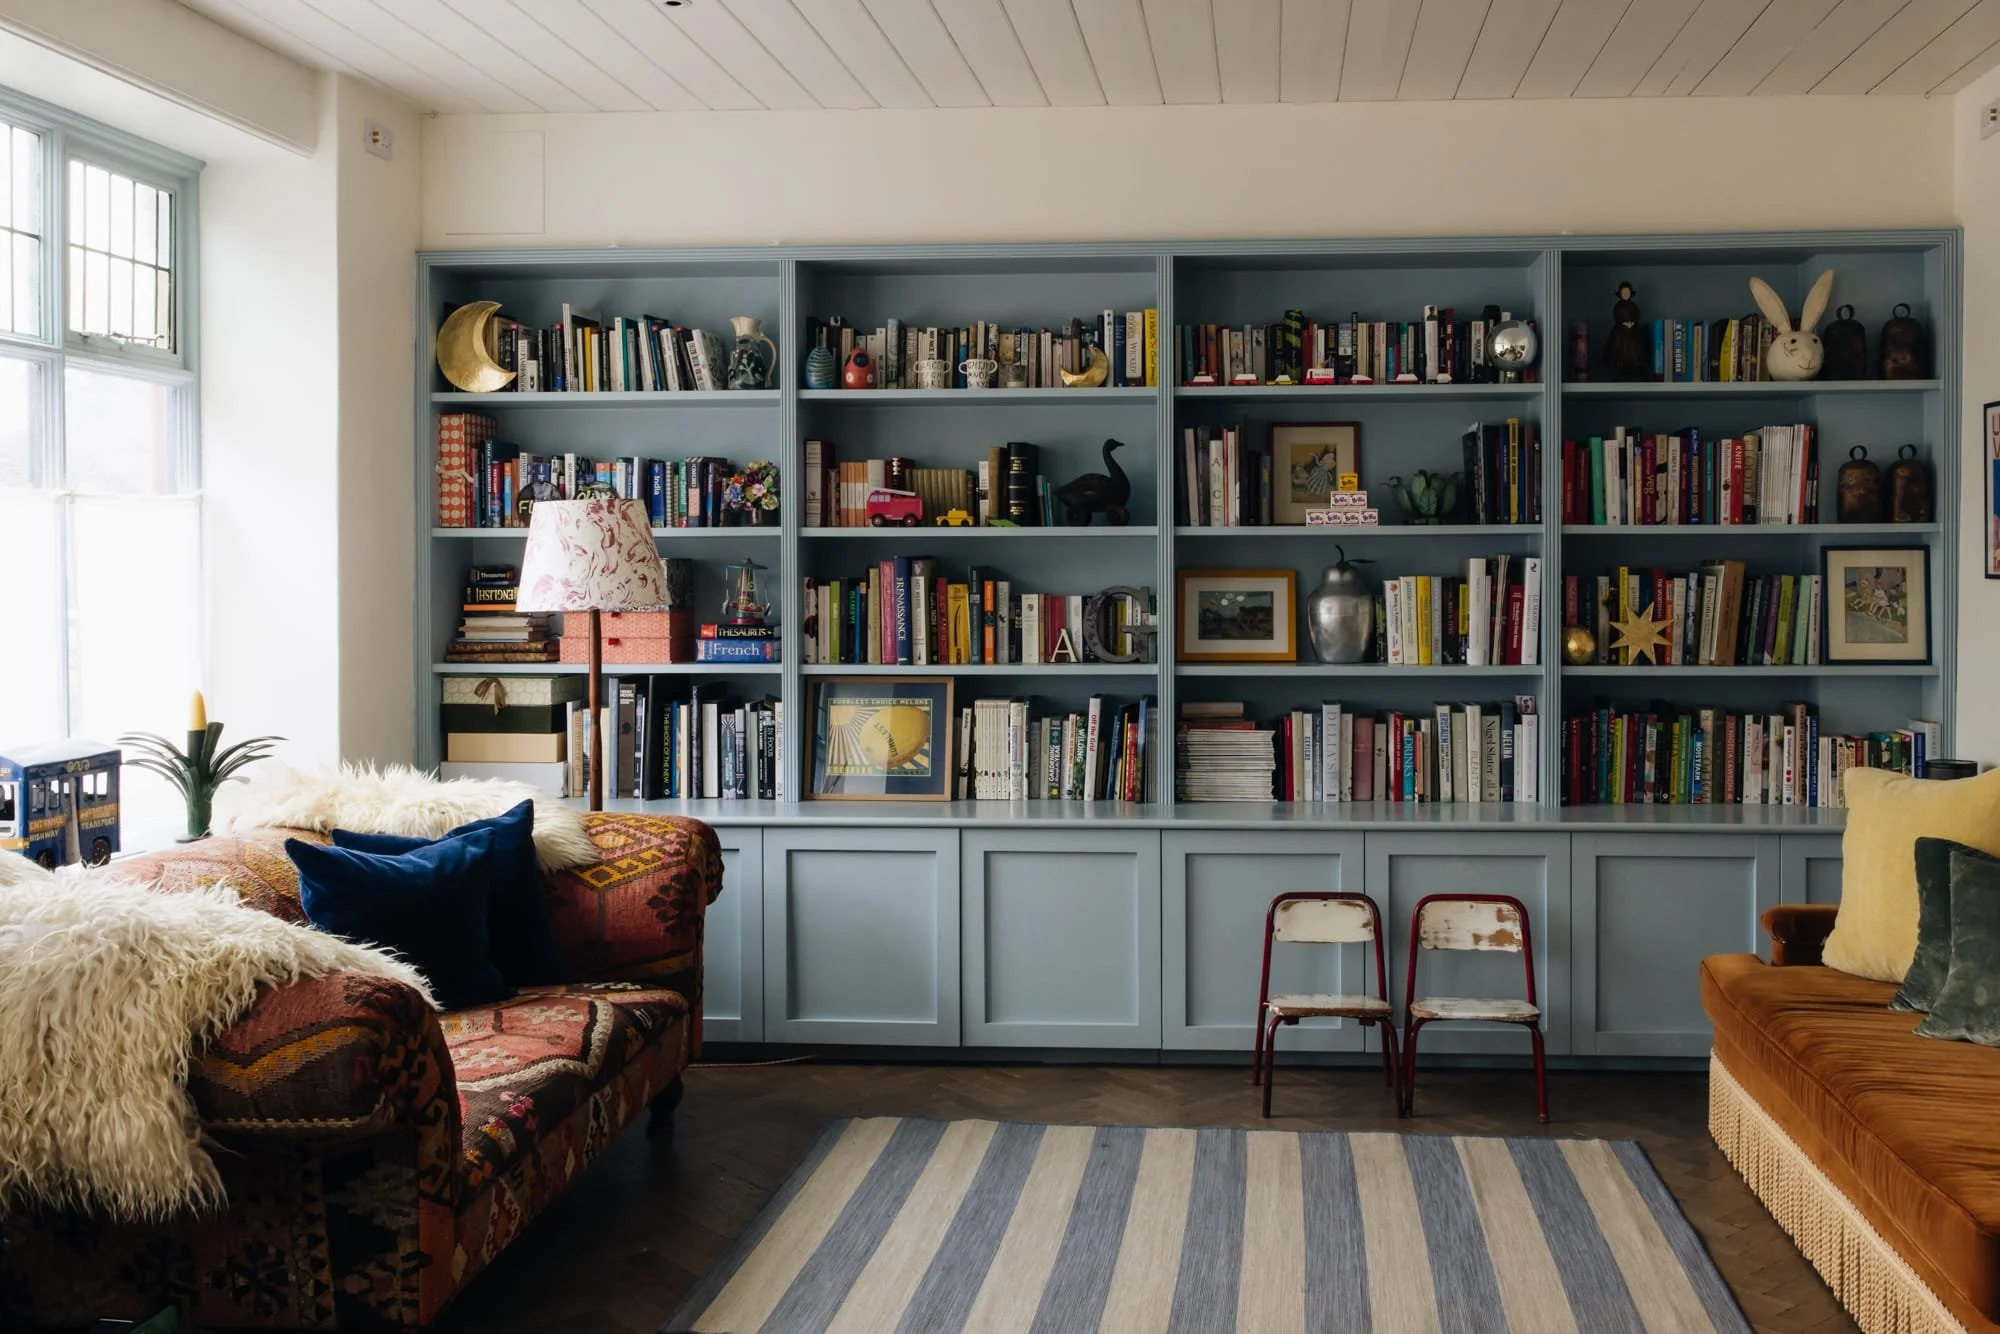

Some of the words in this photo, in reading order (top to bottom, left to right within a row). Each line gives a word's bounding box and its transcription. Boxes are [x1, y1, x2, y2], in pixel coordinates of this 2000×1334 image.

[1734, 446, 1742, 470] KNIFE
[479, 590, 514, 600] ENGLISH
[896, 582, 906, 641] RENAISSANCE
[1084, 586, 1158, 664] G
[719, 628, 766, 637] THESAURUS
[1050, 628, 1079, 663] A
[712, 643, 760, 656] French
[1440, 712, 1448, 743] JERUSALEM
[1486, 720, 1496, 744] Nigel
[1076, 728, 1086, 762] WILDING
[1404, 737, 1413, 776] DRINKS
[1470, 750, 1478, 787] PLENTY
[1487, 746, 1496, 774] Slater
[30, 830, 59, 841] HIGHWAY
